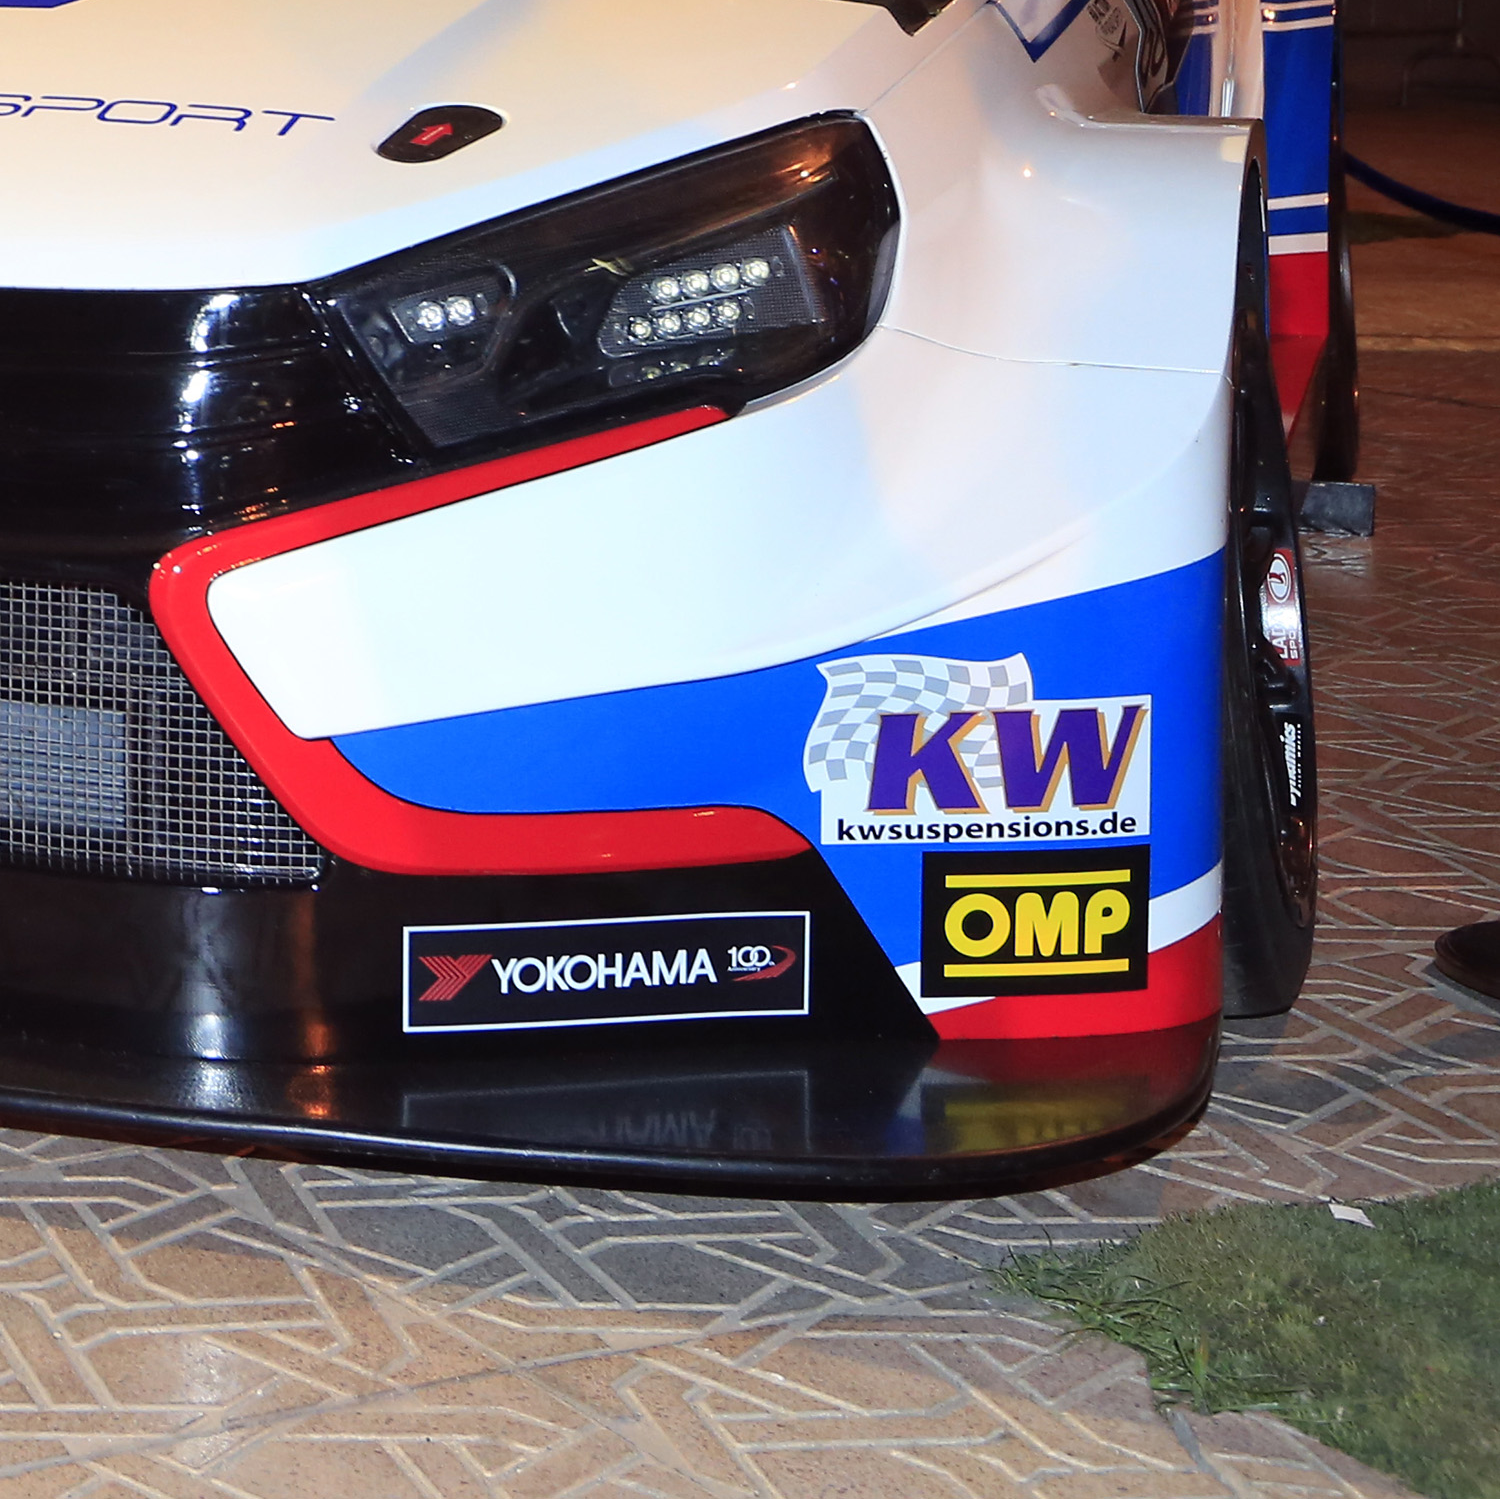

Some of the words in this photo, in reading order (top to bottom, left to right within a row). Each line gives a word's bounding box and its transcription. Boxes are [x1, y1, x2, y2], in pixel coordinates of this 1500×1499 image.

[866, 703, 1148, 816] KW
[836, 813, 1138, 844] kwsuspensions.de
[943, 890, 1132, 959] OMP
[491, 948, 718, 996] YOKOHAMA
